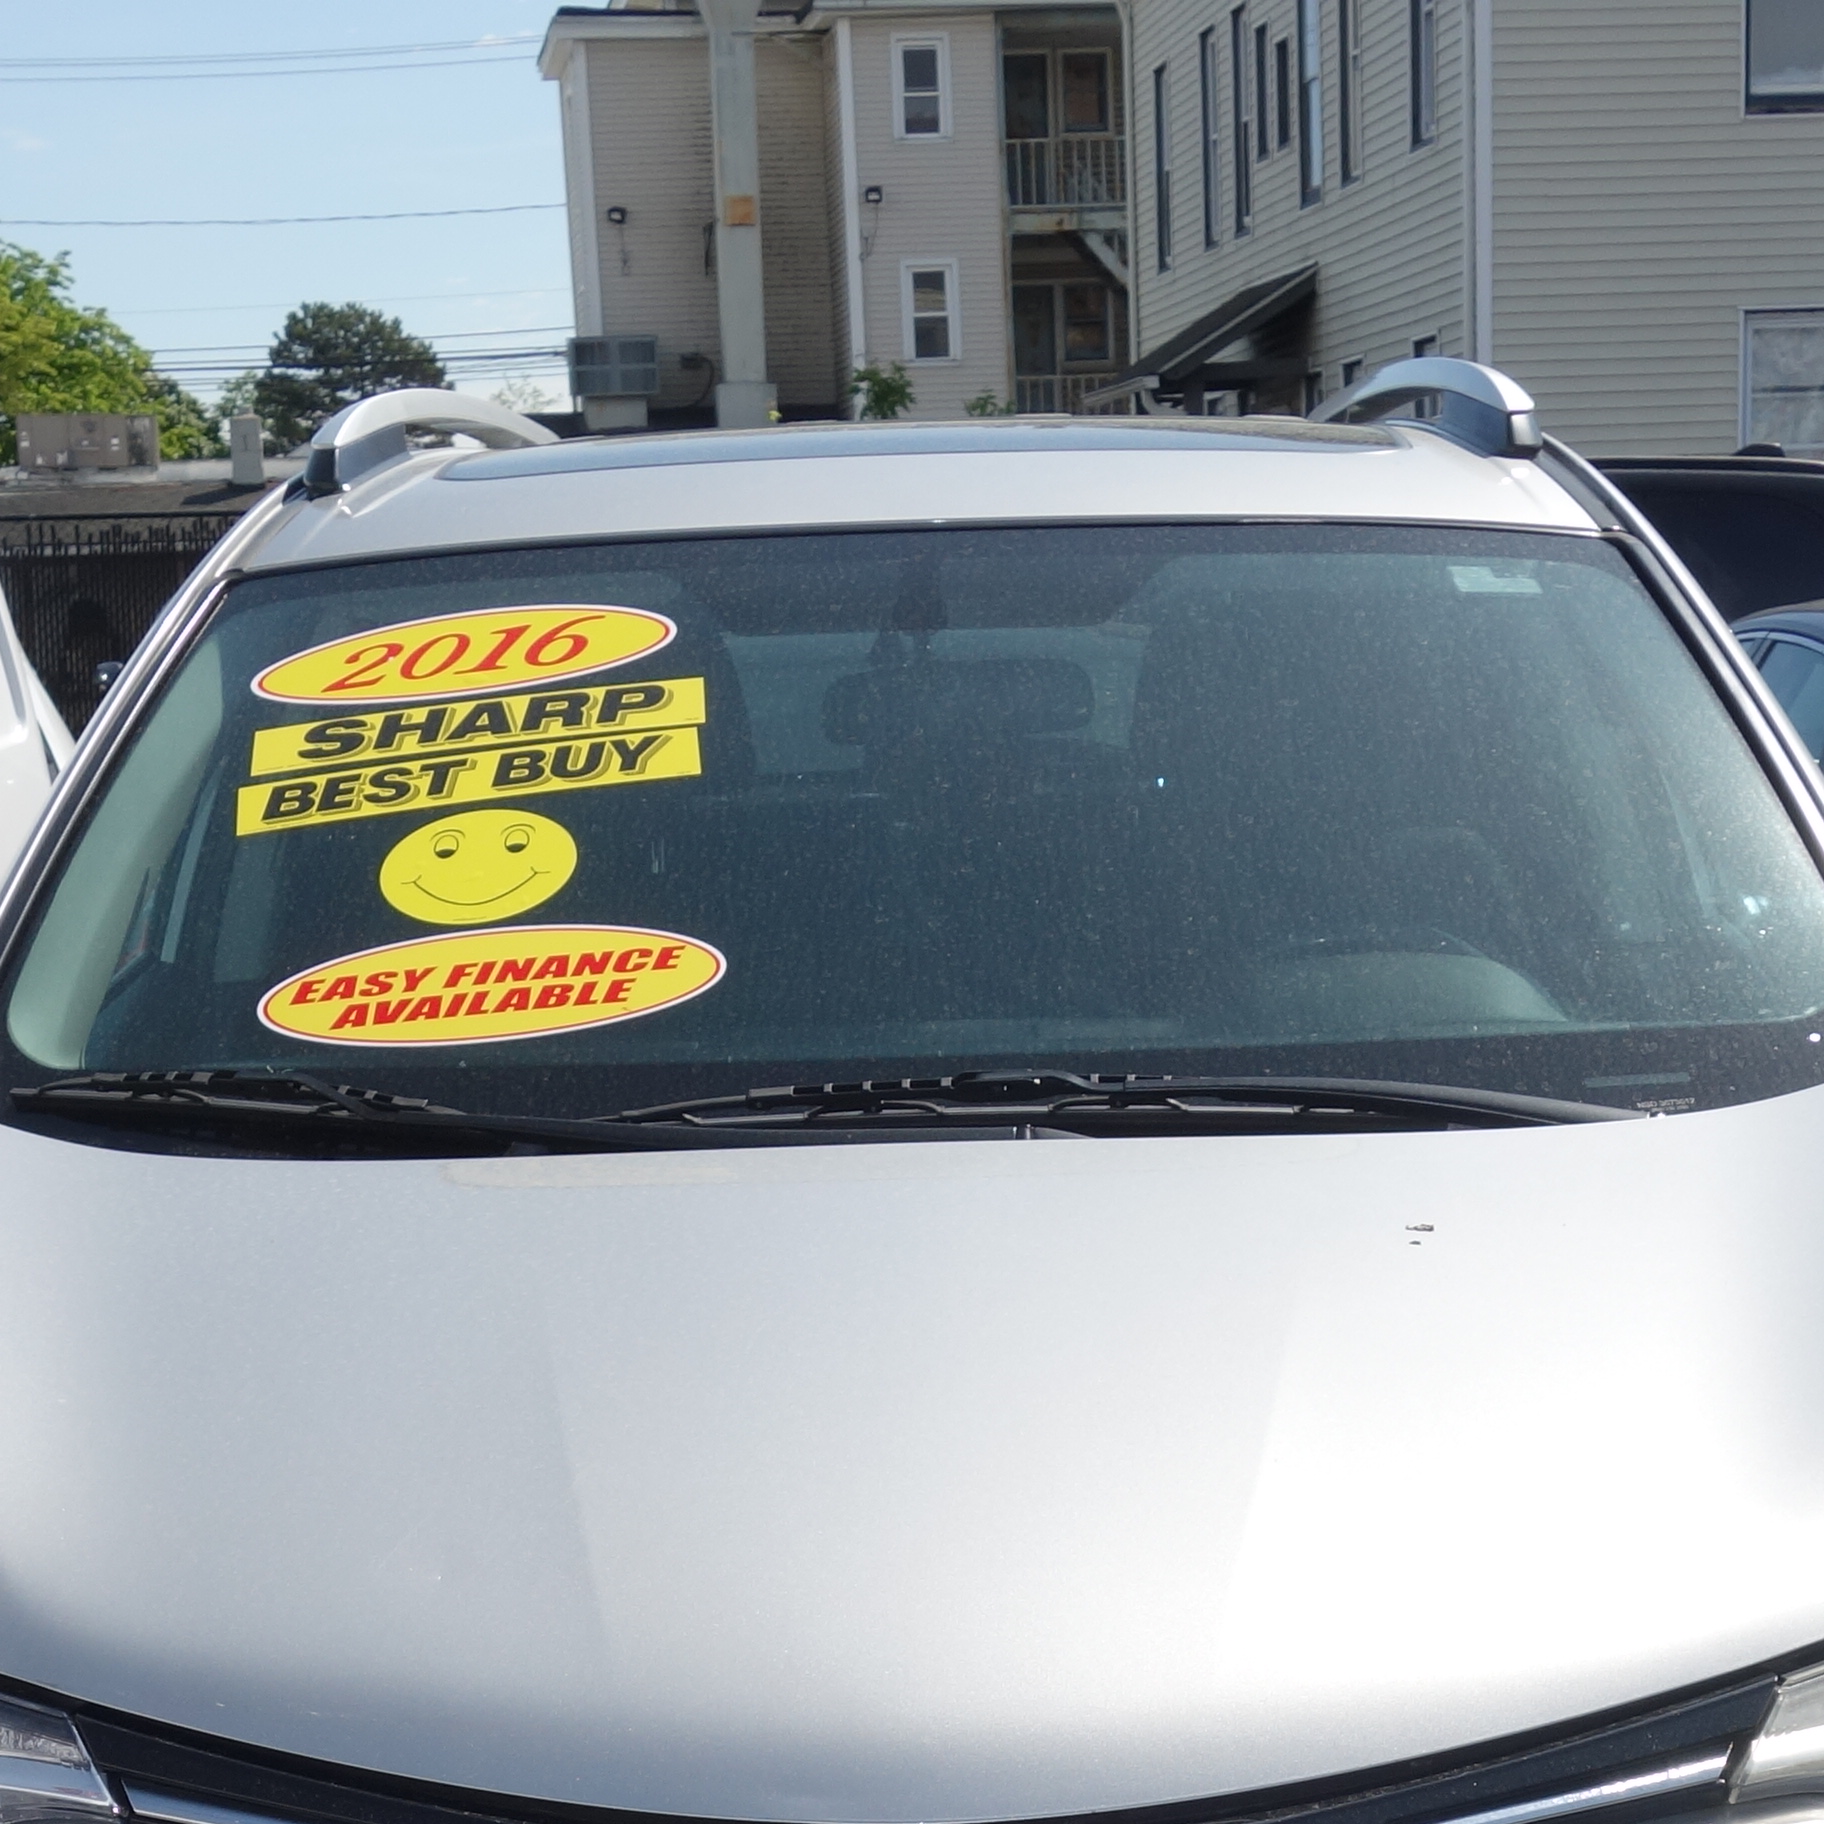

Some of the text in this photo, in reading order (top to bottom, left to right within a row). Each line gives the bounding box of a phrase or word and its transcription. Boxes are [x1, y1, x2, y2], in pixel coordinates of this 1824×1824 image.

[319, 614, 606, 693] 2016
[296, 683, 674, 761] SHARP
[260, 732, 675, 825] BEST BUY
[288, 944, 688, 1007] EASY FINANCE
[328, 976, 639, 1032] AVAILABLE
